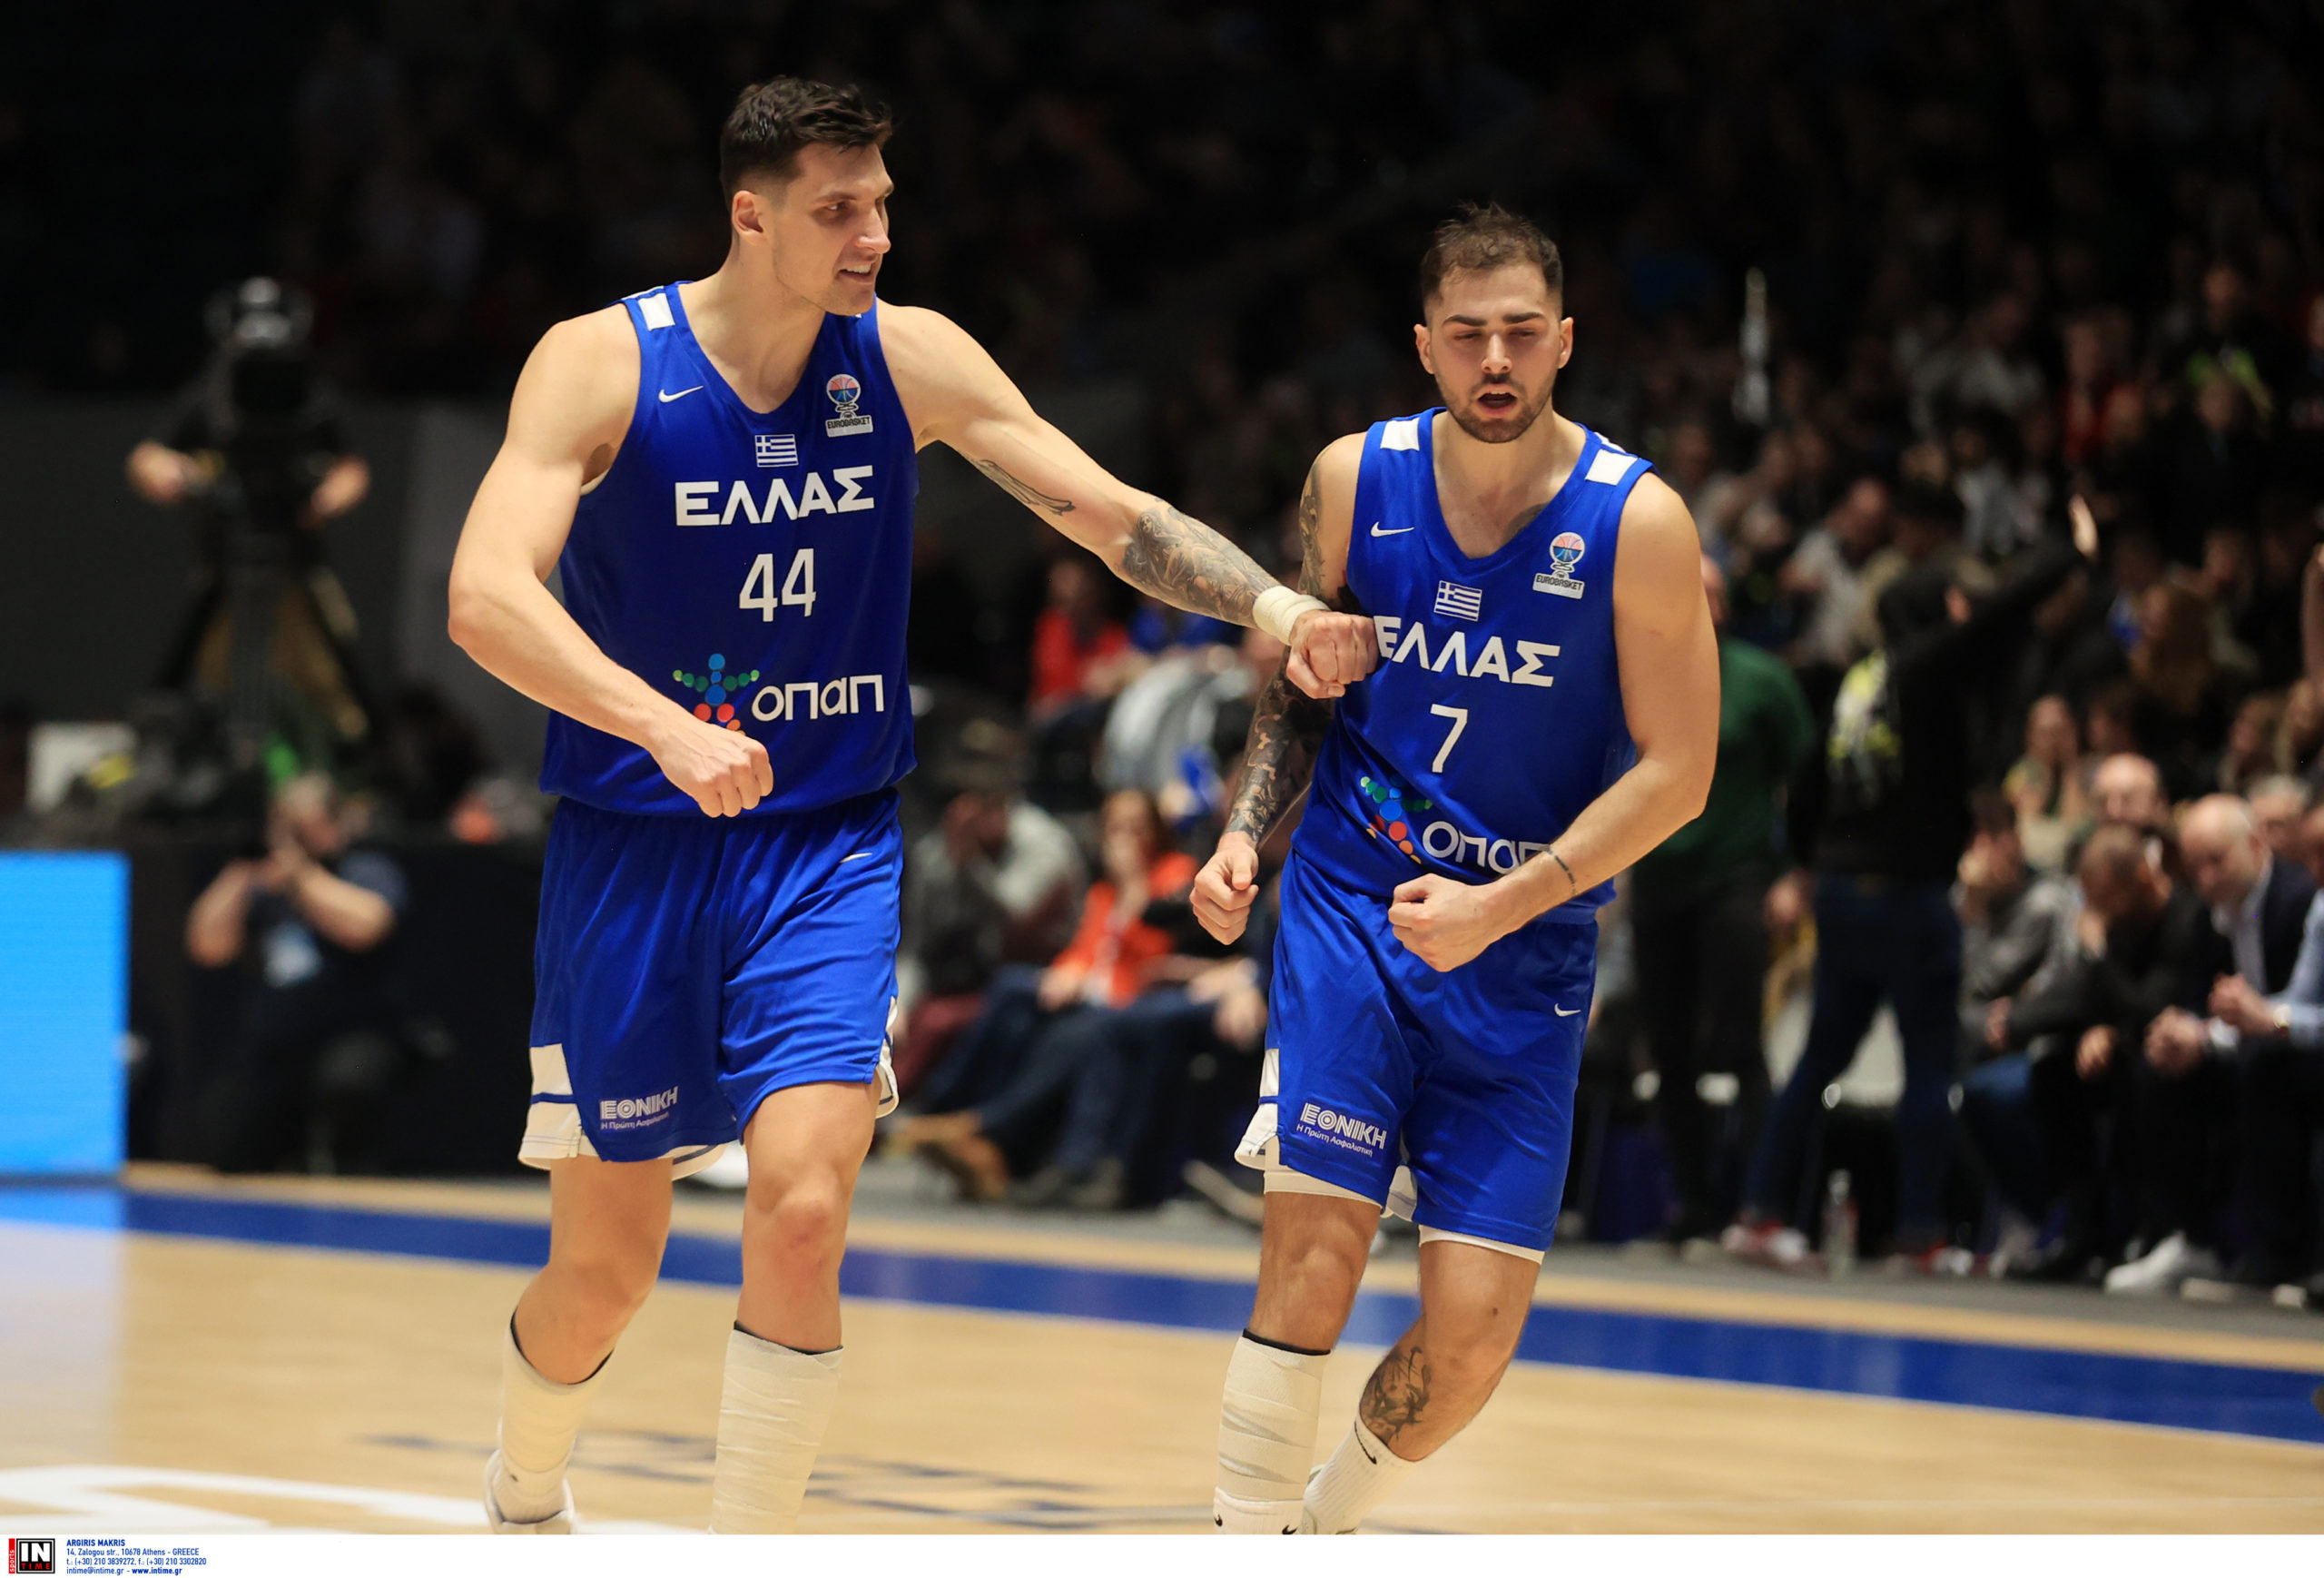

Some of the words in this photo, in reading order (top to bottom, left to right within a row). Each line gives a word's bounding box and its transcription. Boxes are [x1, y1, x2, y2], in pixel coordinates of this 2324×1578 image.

[675, 465, 875, 526] ΕΛΛΑΣ
[739, 548, 817, 622] 44
[1536, 575, 1582, 591] EUROBASKET
[1374, 616, 1561, 687] ΕΛΛΑΣ
[1430, 704, 1469, 774] 7
[1296, 1124, 1304, 1132] Η
[1304, 1127, 1330, 1143] Πρώτη
